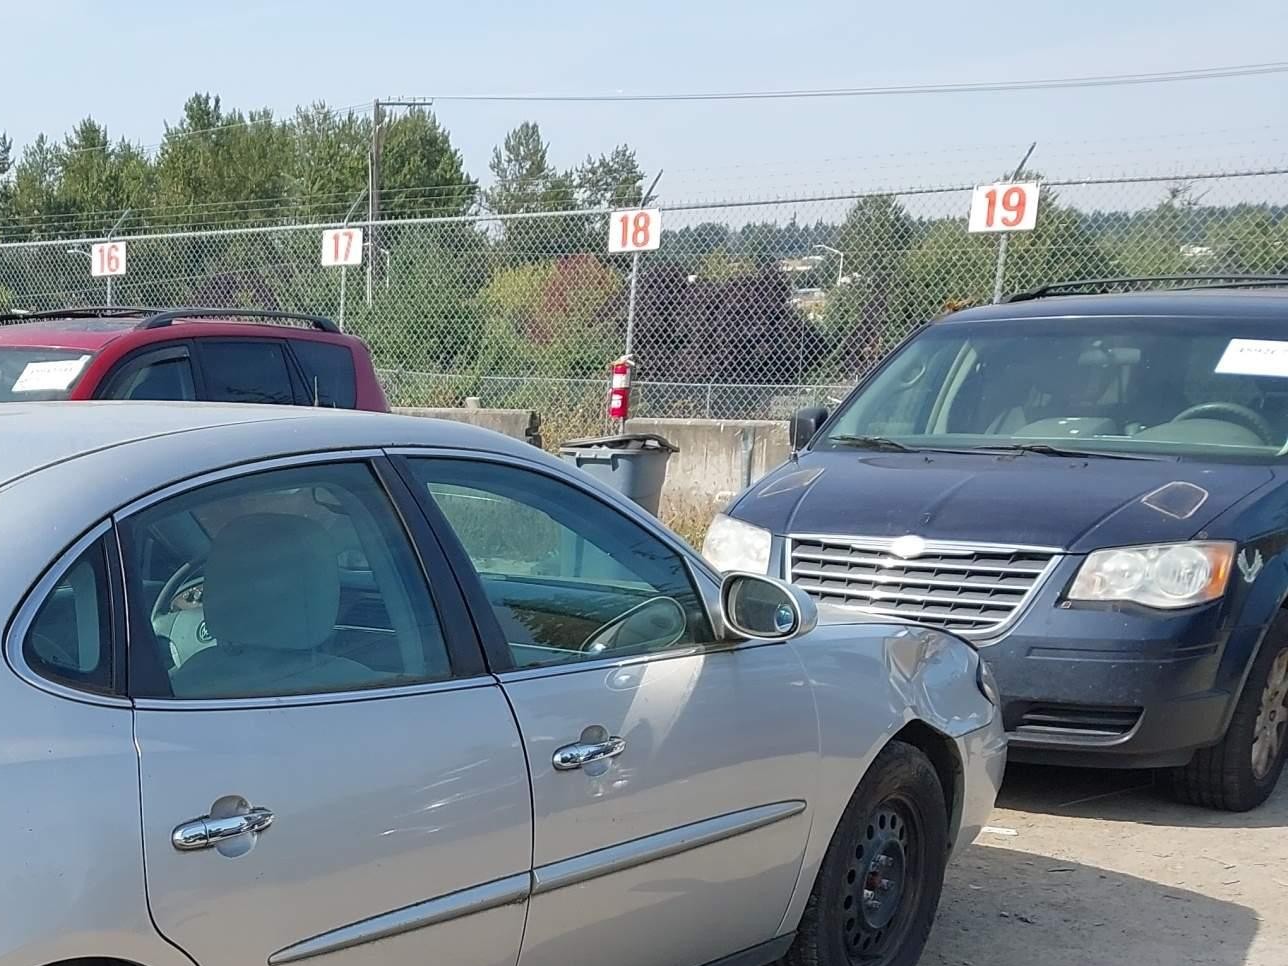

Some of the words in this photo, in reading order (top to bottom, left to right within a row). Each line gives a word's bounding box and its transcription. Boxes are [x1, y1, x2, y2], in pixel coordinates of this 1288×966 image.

[985, 186, 1026, 228] 19
[333, 231, 353, 262] 17
[620, 211, 650, 249] 18
[99, 244, 119, 273] 16
